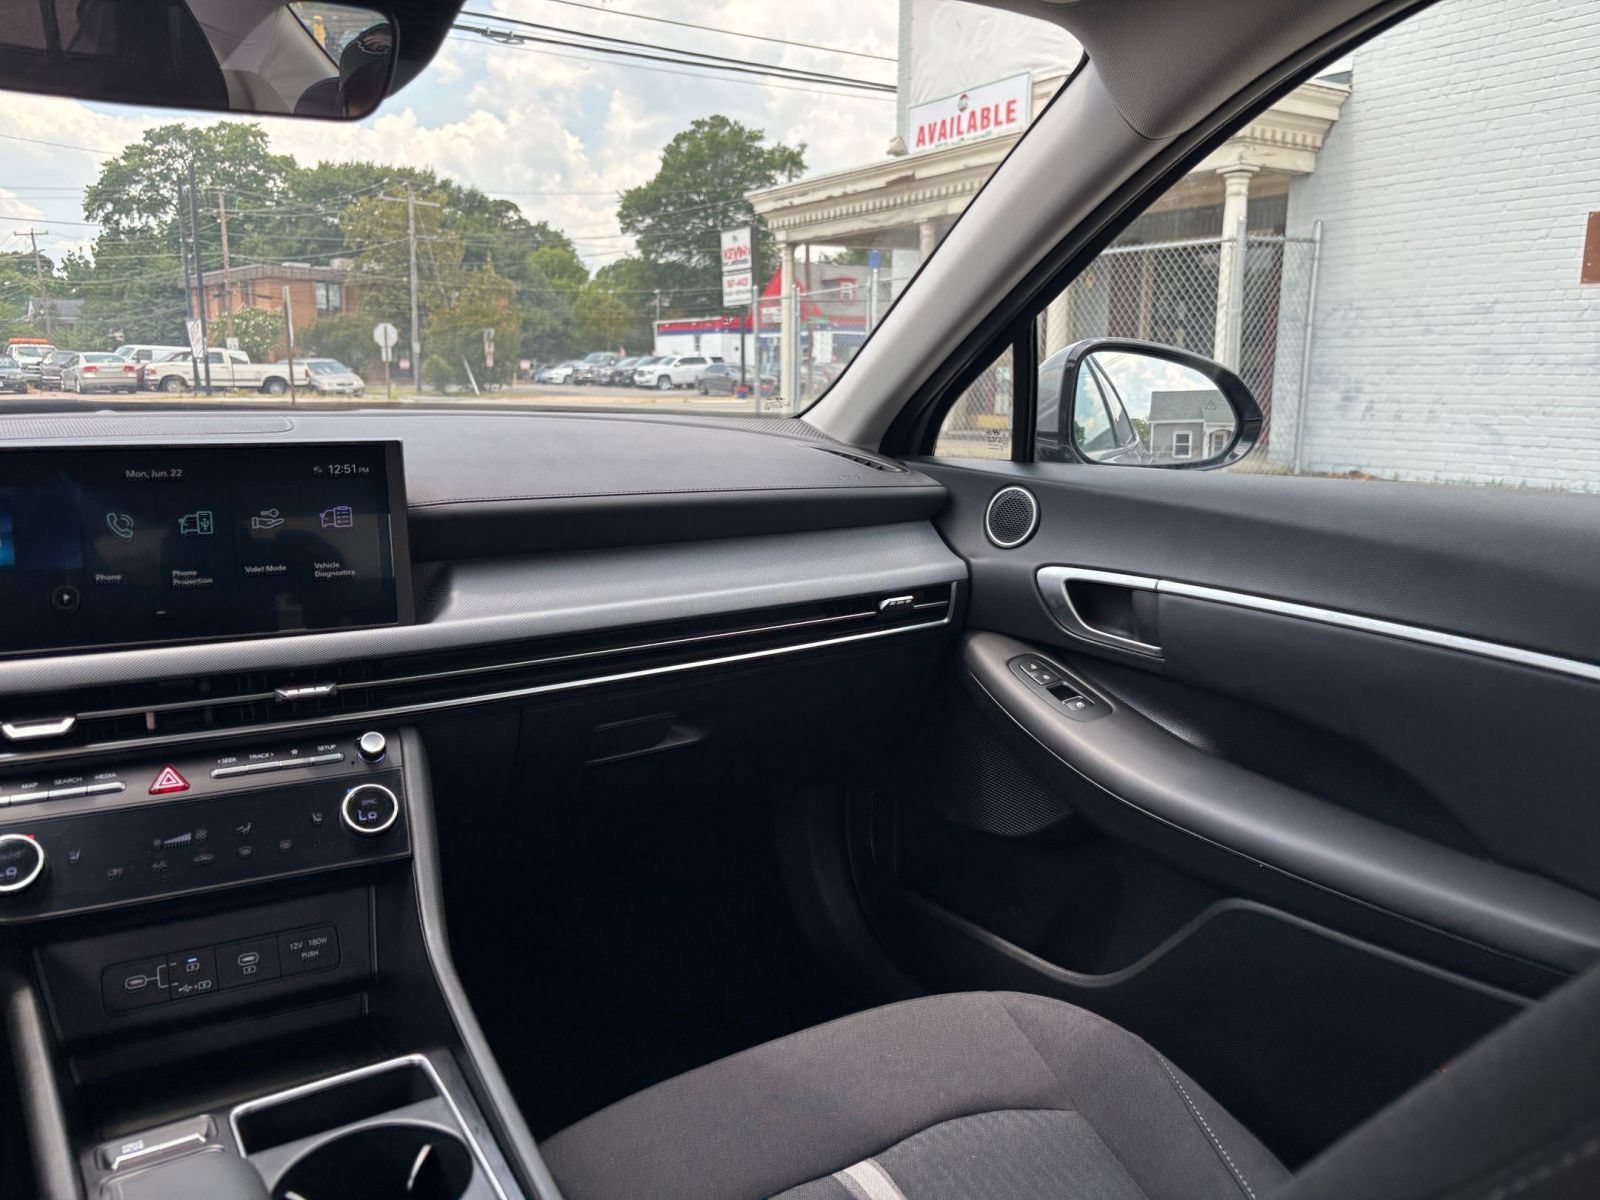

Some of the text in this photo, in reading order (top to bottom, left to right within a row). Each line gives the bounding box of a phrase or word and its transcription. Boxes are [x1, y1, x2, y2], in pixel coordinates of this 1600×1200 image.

[916, 99, 1017, 148] AVAILABLE
[170, 468, 183, 477] 22
[328, 464, 357, 474] 12:51
[315, 570, 356, 578] Diagnostics
[54, 776, 83, 786] SEARCH
[21, 782, 39, 790] MAP
